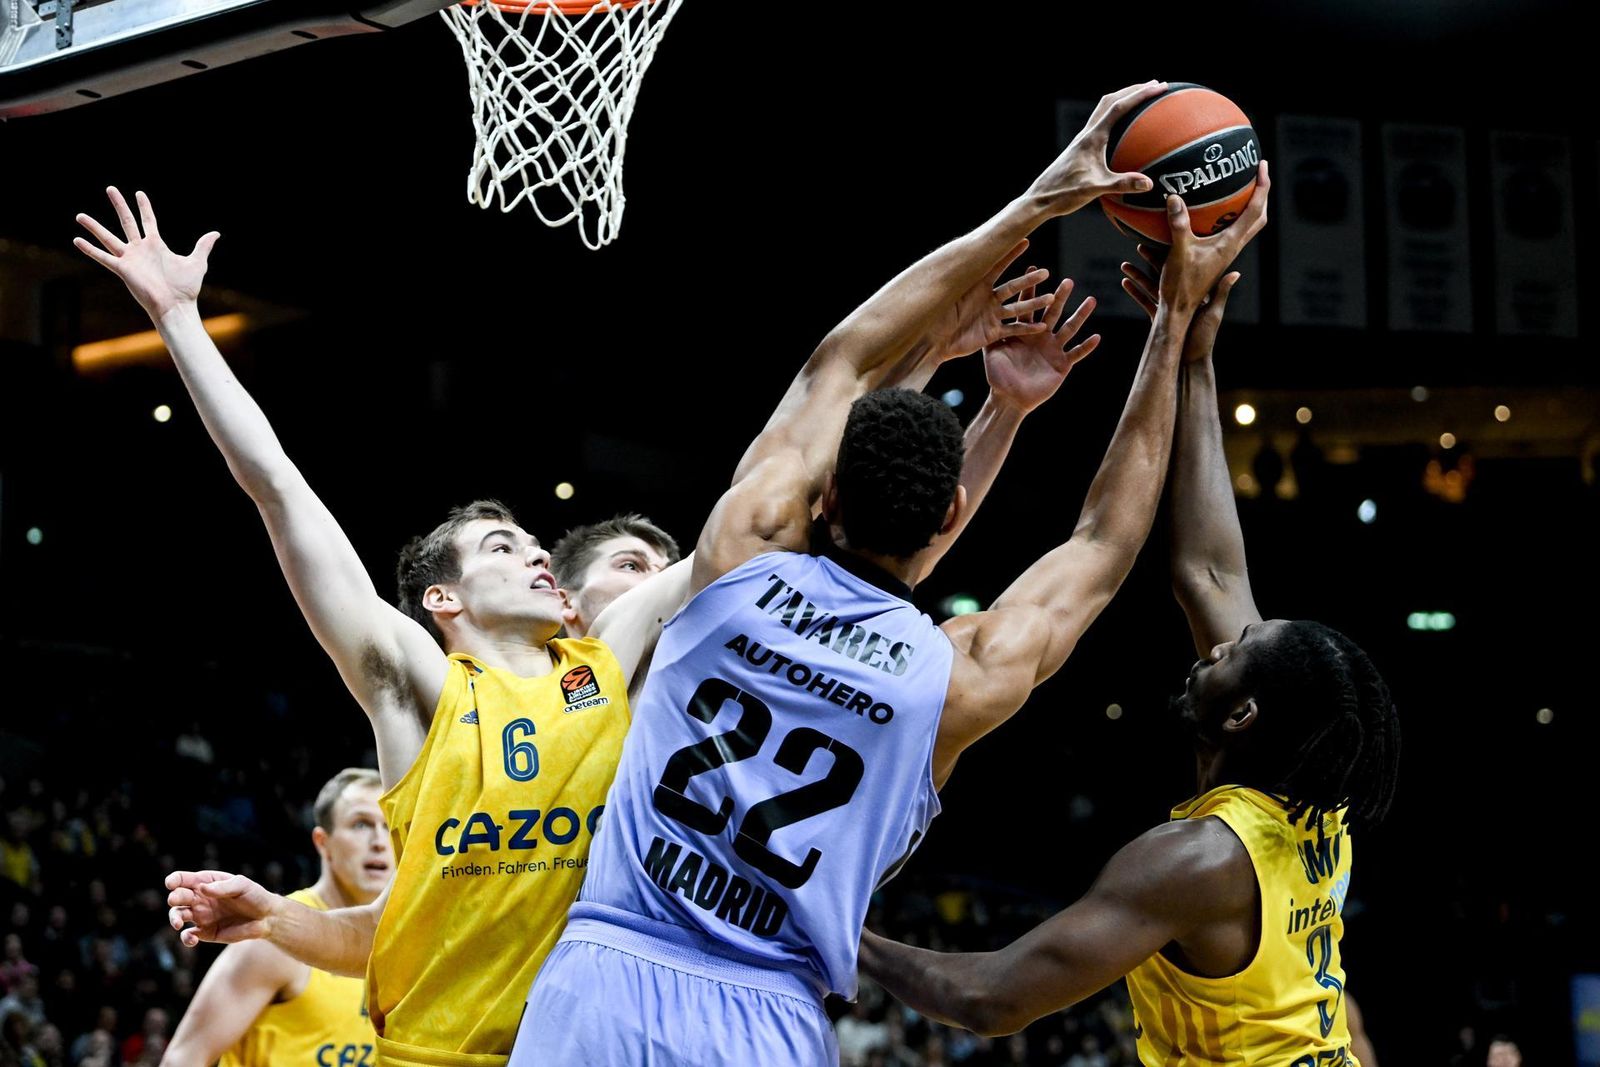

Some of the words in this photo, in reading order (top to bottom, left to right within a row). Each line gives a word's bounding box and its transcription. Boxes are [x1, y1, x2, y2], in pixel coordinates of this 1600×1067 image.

[1158, 138, 1259, 200] SPALDING
[754, 573, 914, 677] TAVARES
[724, 633, 894, 725] AUTOHERO
[502, 717, 540, 782] 6
[653, 677, 865, 890] 22
[441, 864, 495, 879] Finden.
[498, 860, 551, 875] Fahren.
[643, 836, 788, 937] MADRID
[1306, 924, 1343, 1039] 3
